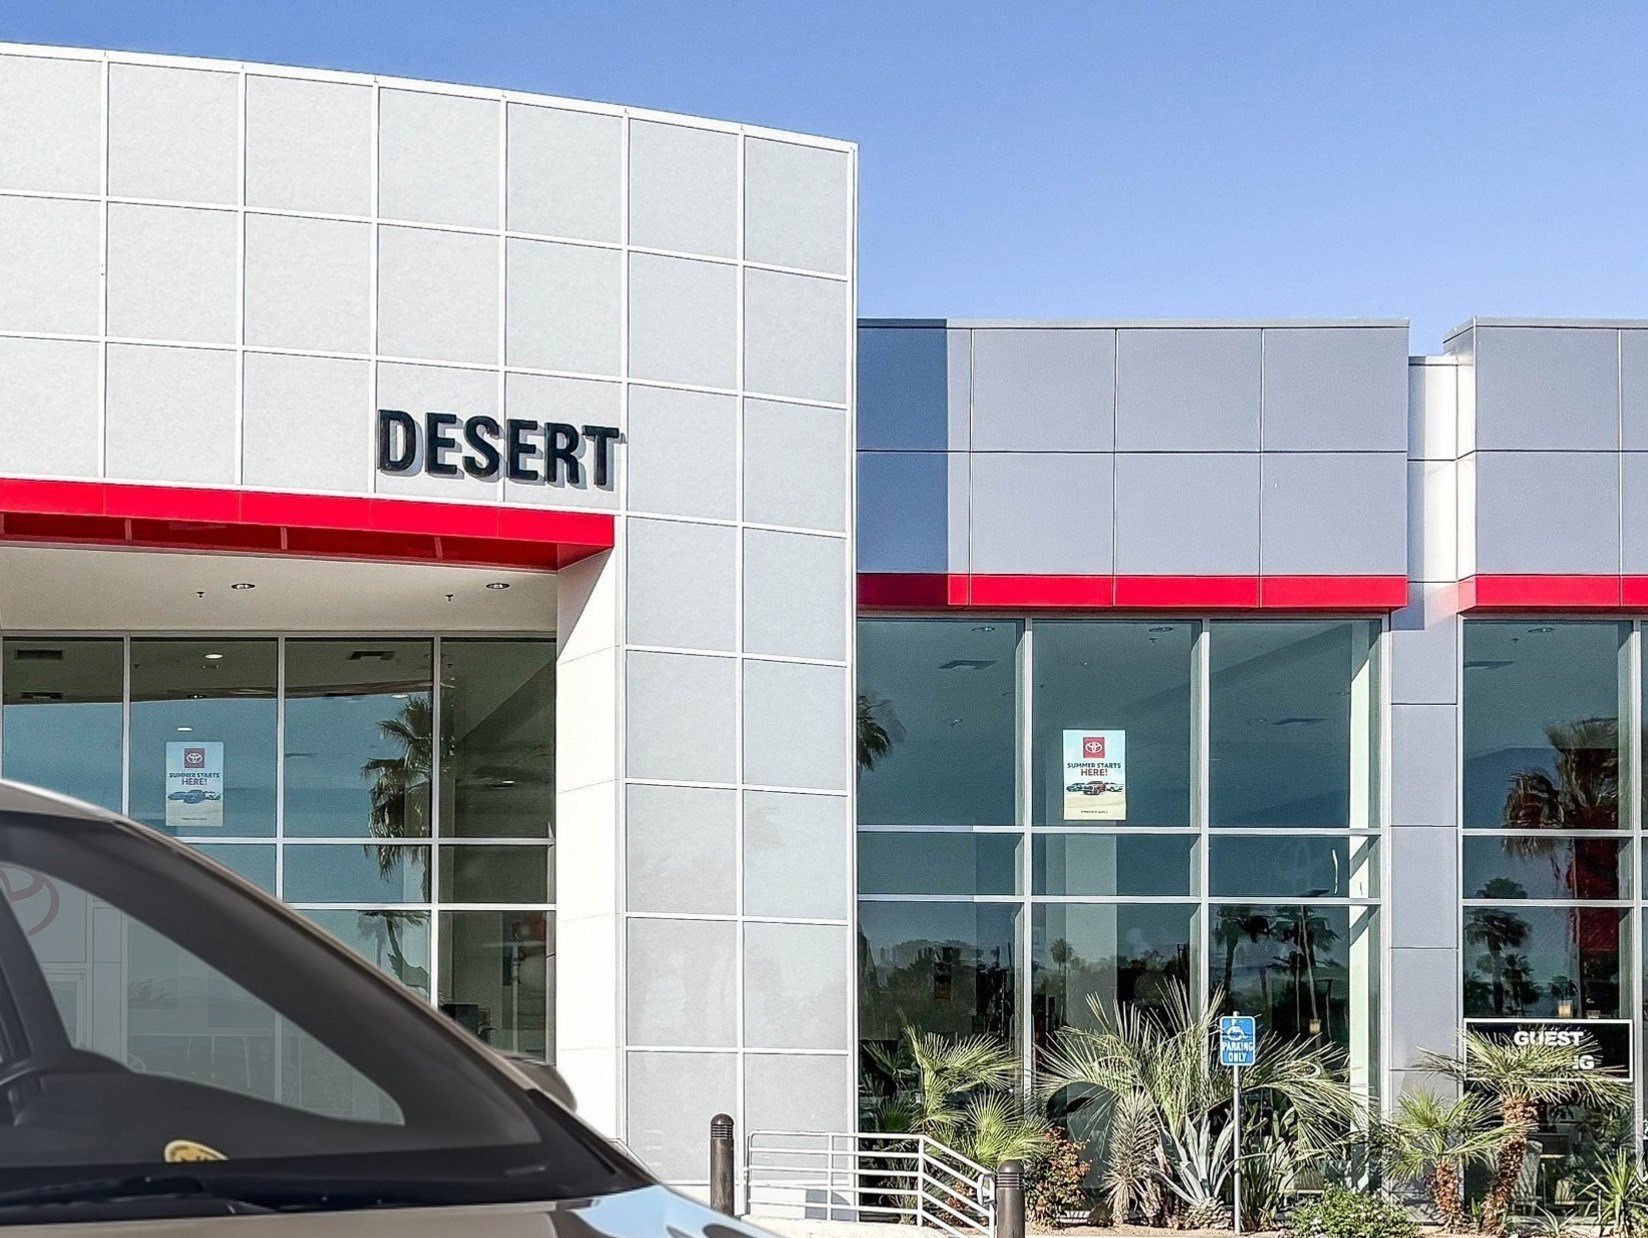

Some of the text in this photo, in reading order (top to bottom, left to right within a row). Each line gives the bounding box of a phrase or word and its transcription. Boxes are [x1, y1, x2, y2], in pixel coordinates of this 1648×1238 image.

[377, 409, 620, 486] DESERT
[1080, 768, 1108, 776] HERE!
[181, 778, 208, 786] HERE!
[1513, 1030, 1584, 1047] GUEST
[1221, 1041, 1254, 1051] PARKING
[1228, 1052, 1248, 1062] ONLY
